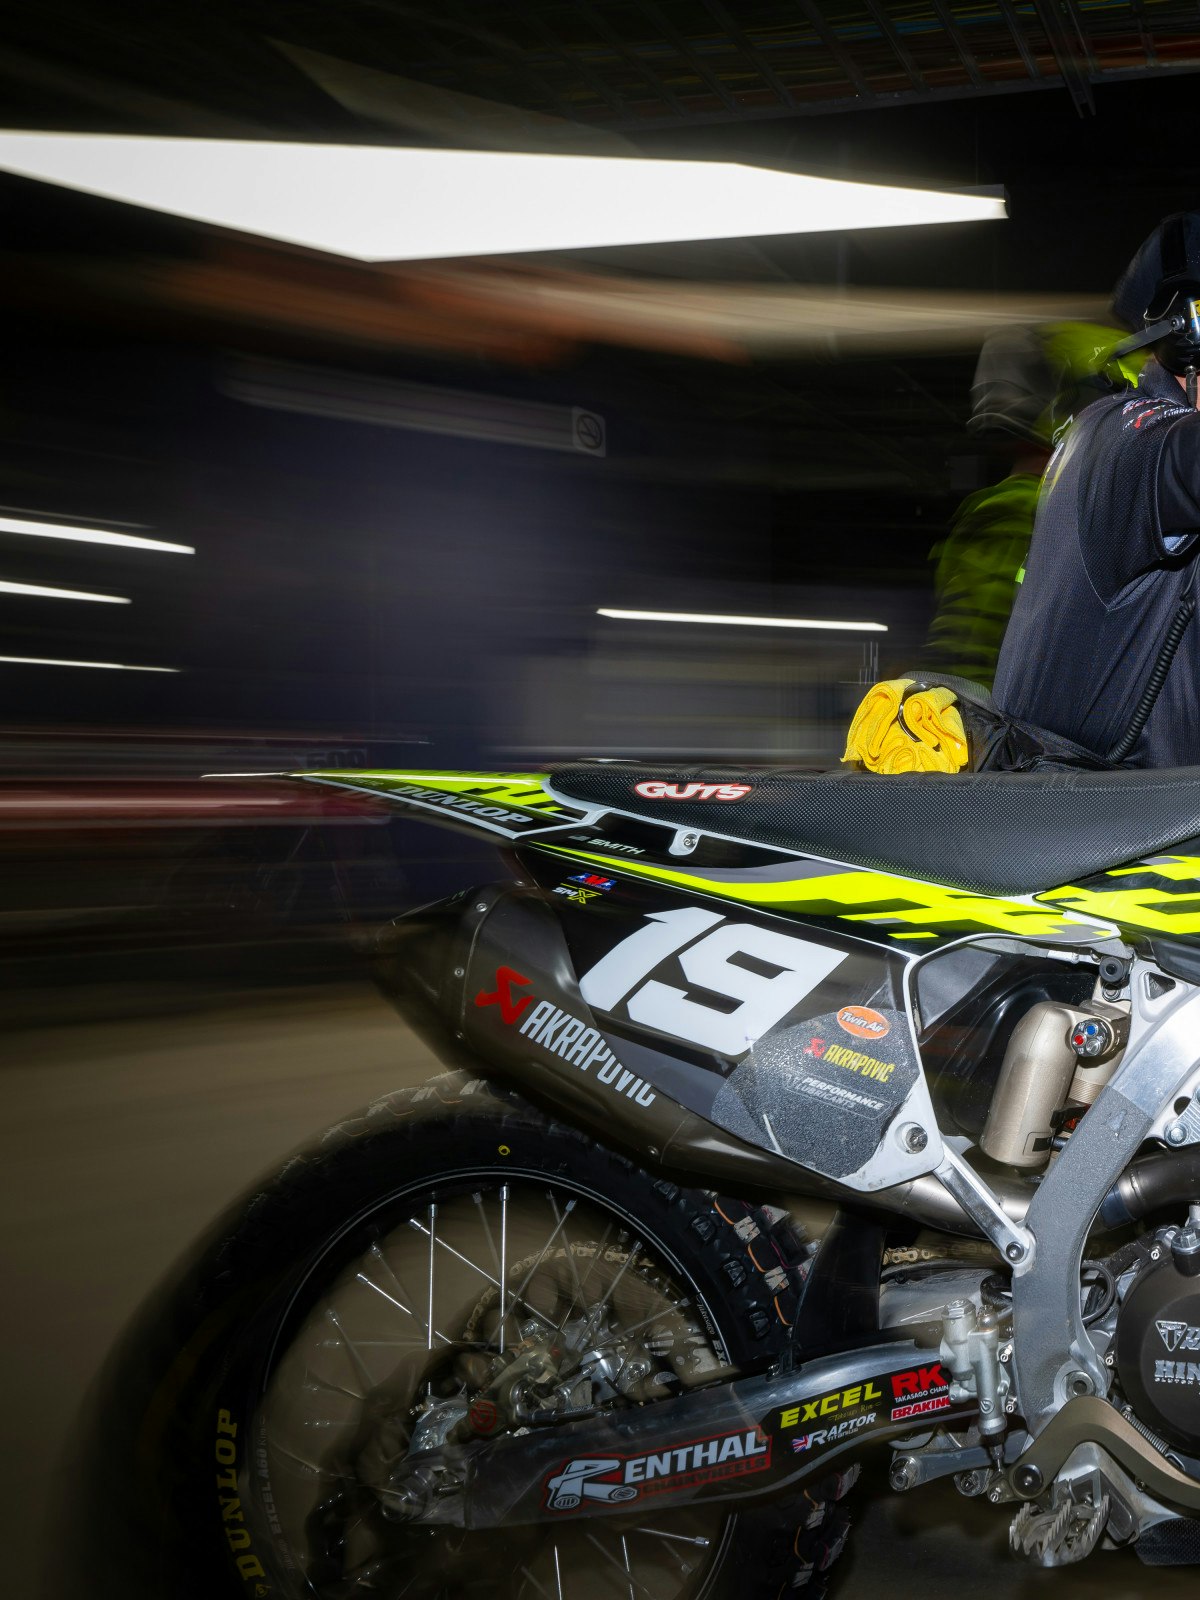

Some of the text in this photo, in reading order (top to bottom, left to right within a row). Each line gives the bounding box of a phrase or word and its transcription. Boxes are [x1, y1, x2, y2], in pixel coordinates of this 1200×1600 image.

[398, 786, 533, 826] DUNLOP
[635, 781, 752, 800] GUTS
[587, 838, 647, 855] SMITH
[579, 906, 849, 1057] 19
[841, 1011, 885, 1033] Twin Air
[802, 1076, 885, 1110] PERFORMANCE
[890, 1363, 948, 1398] RK
[894, 1390, 929, 1404] TAKASAGO
[779, 1382, 882, 1429] EXCEL
[805, 1412, 877, 1450] RAPTOR
[256, 1449, 270, 1479] A60
[547, 1431, 768, 1510] RENTHAL
[215, 1408, 266, 1582] DUNLOP
[262, 1481, 283, 1535] EXCEL
